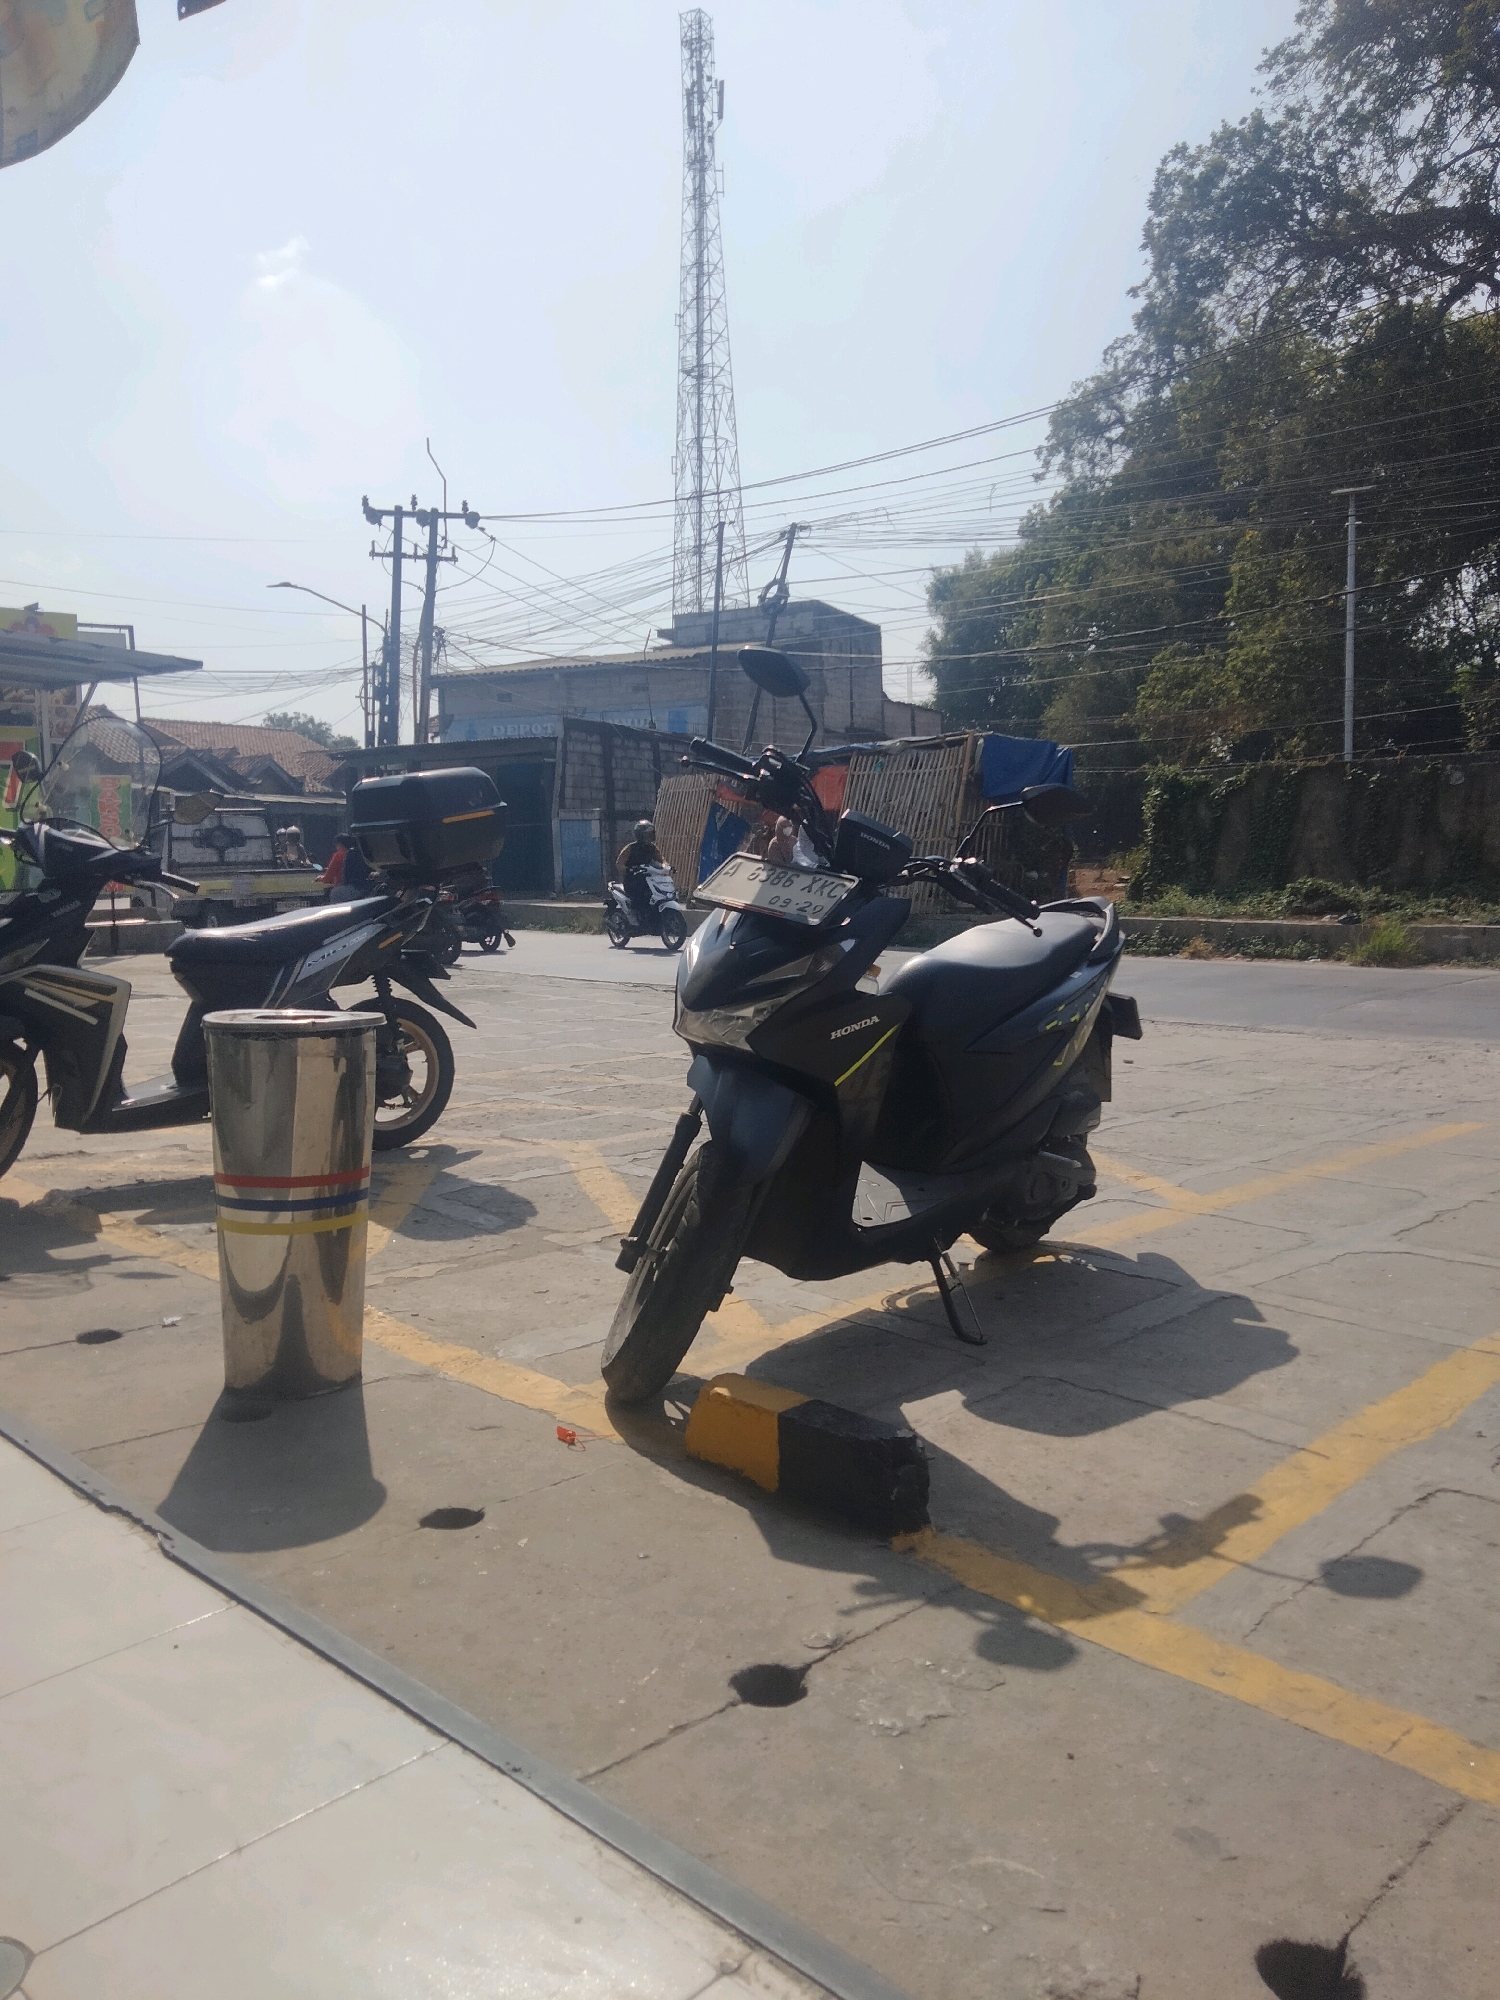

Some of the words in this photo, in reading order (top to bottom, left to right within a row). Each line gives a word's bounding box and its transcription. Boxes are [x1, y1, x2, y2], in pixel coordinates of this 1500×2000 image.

[492, 722, 555, 737] DEPOT
[860, 831, 890, 850] HONDA
[723, 861, 744, 878] A
[747, 866, 800, 889] 6386
[800, 875, 847, 899] XKC
[830, 1015, 880, 1040] HONDA
